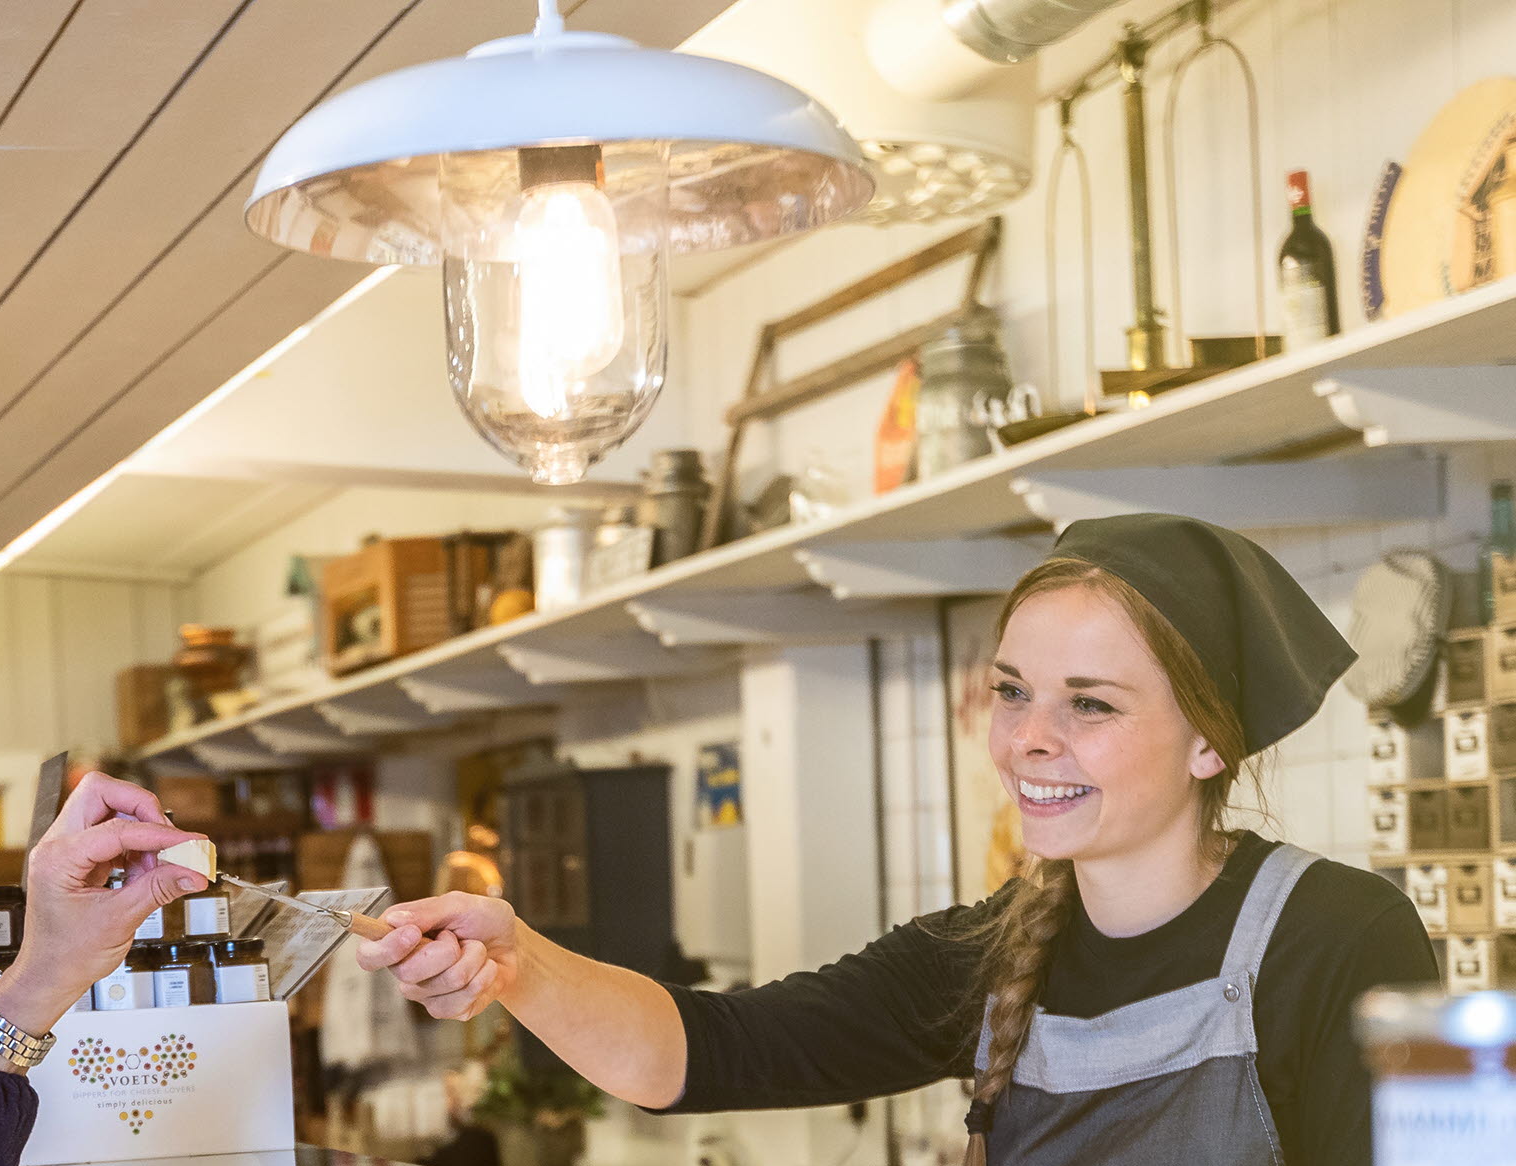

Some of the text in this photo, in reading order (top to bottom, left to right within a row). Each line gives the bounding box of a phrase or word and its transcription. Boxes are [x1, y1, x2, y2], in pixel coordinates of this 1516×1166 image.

[109, 1074, 159, 1086] VOETS
[110, 1089, 126, 1097] FOR
[130, 1087, 162, 1096] CHEESE
[164, 1086, 196, 1094] LOVERS
[97, 1098, 173, 1109] simply delicious
